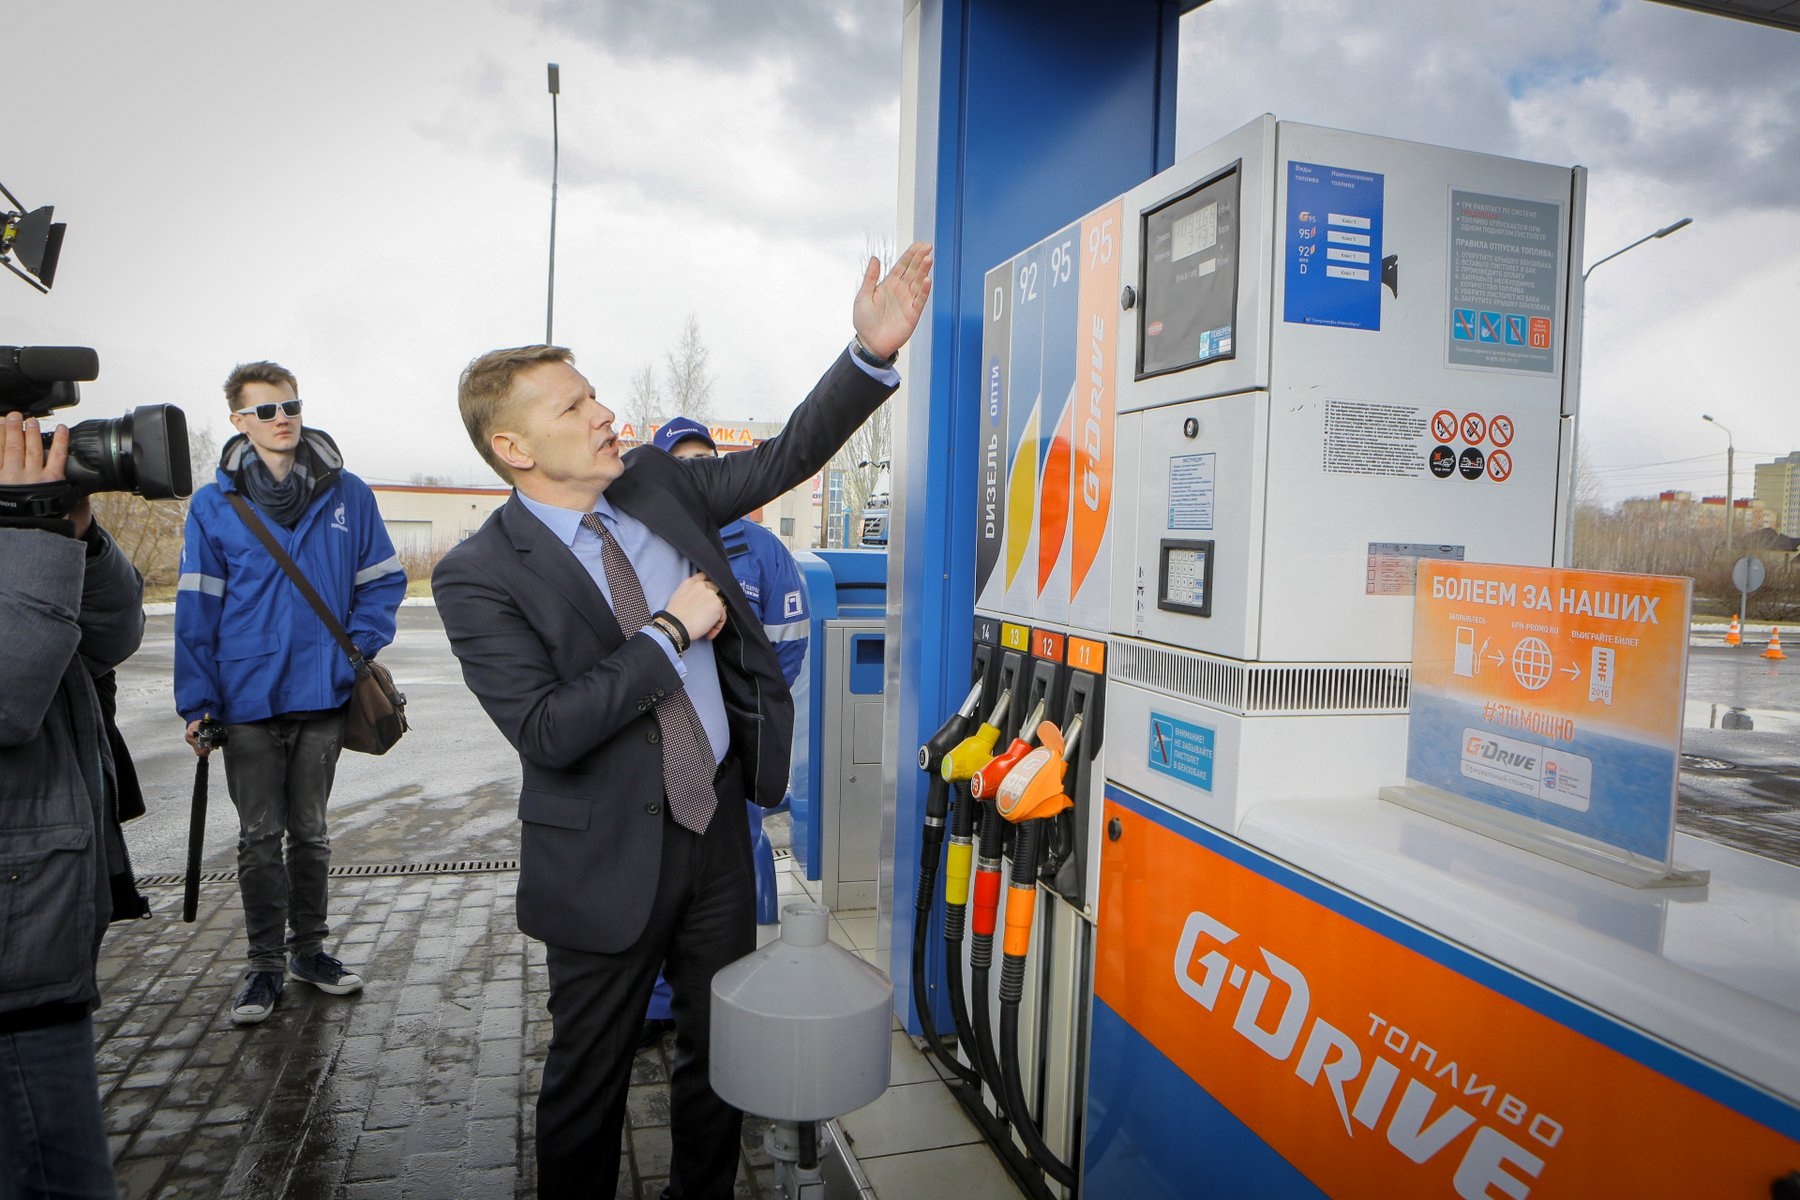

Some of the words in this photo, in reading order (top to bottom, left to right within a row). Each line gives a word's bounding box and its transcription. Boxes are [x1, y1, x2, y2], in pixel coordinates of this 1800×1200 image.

[1089, 218, 1113, 270] 95
[1299, 228, 1310, 240] 95
[1298, 245, 1310, 257] 92
[1456, 238, 1488, 250] ПРАВИЛА
[1489, 242, 1521, 253] ОТПУСКА
[1051, 240, 1072, 288] 95
[1300, 264, 1308, 275] D
[1019, 262, 1038, 305] 92
[993, 286, 1004, 322] D
[1534, 333, 1546, 347] 01
[990, 365, 1000, 417] ОПТИ
[1432, 575, 1518, 608] БОЛЕЕМ
[1522, 584, 1554, 612] ЗА
[1559, 587, 1661, 625] НАШИХ
[1448, 612, 1488, 625] ЗАПРАВЬТЕСЬ
[981, 623, 991, 640] 14
[1010, 628, 1021, 645] 13
[1571, 630, 1613, 644] ВЫИГРАЙТЕ
[1614, 636, 1640, 647] БИЛЕТ
[1042, 636, 1054, 656] 12
[1079, 644, 1092, 665] 11
[1591, 687, 1610, 698] 2016
[1482, 701, 1575, 743] #ЭТОМОЩНО
[1464, 763, 1508, 784] Официальный
[1368, 1012, 1564, 1149] ТОПЛИВО
